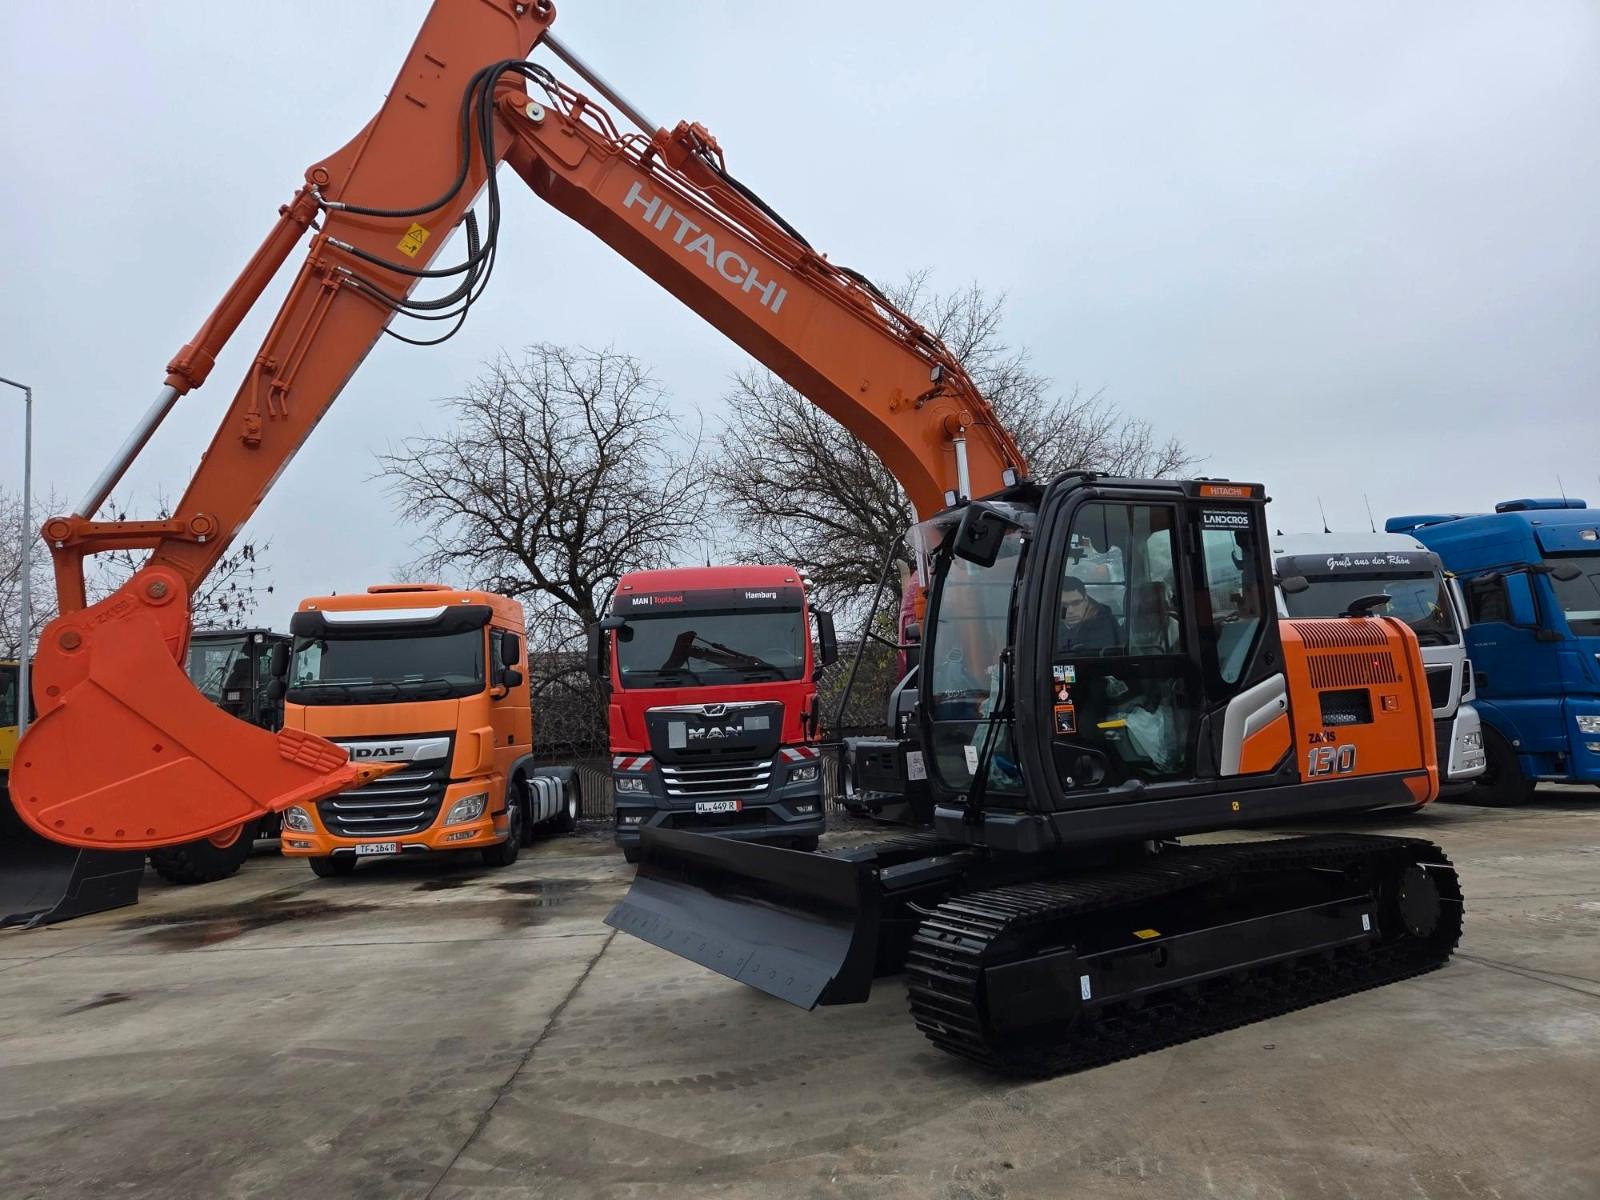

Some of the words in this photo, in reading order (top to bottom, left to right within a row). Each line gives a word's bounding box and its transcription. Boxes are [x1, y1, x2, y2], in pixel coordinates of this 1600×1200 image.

[622, 180, 788, 315] HITACHI
[1210, 487, 1242, 496] HITACHI
[1203, 514, 1249, 525] LANDCROS
[1326, 556, 1352, 571] Gruß
[1354, 558, 1370, 566] aus
[1372, 556, 1386, 565] der
[632, 597, 649, 606] MAN
[654, 595, 683, 605] TopUsed
[745, 591, 777, 600] Hamburg
[688, 725, 743, 740] MAN
[356, 746, 404, 758] DAF
[1307, 744, 1357, 777] 130
